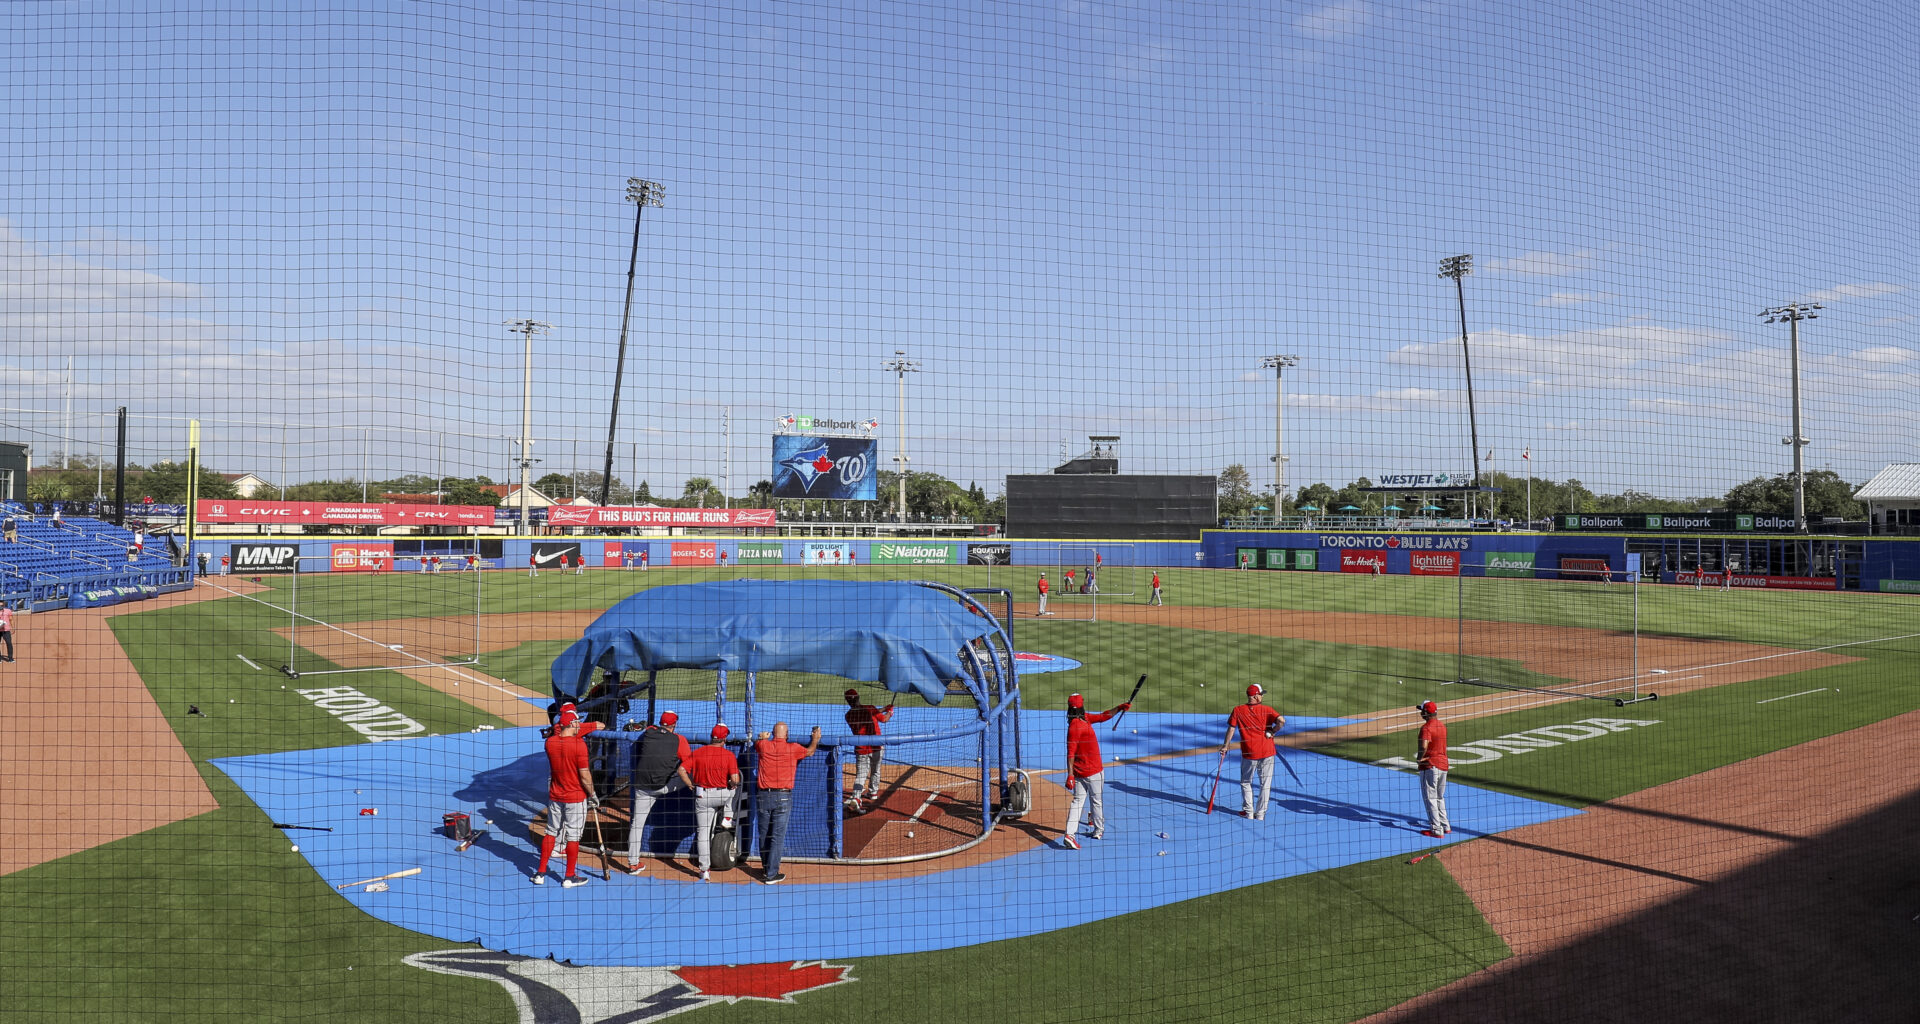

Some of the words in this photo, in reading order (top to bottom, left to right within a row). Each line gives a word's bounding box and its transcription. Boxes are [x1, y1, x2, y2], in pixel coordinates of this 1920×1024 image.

[799, 418, 811, 427] TD
[813, 419, 856, 430] Ballpark
[1380, 475, 1433, 486] WESTJET
[598, 510, 620, 521] THIS
[622, 511, 651, 522] BUD'S
[653, 511, 671, 522] FOR
[673, 512, 700, 523] HOME
[703, 512, 729, 523] RUNS
[1567, 517, 1578, 526] TD
[1581, 517, 1623, 527] Ballpark
[1648, 517, 1660, 527] TD
[1664, 517, 1711, 527] Ballpark
[1738, 517, 1751, 527] TD
[1320, 535, 1385, 548] TORONTO
[1401, 536, 1432, 549] BLUE
[1436, 536, 1469, 550] JAYS
[236, 547, 294, 564] MNP
[699, 549, 714, 558] 5G
[738, 549, 760, 558] PIZZA
[762, 549, 782, 558] NOVA
[1270, 553, 1284, 564] TD
[1297, 554, 1313, 566] TD
